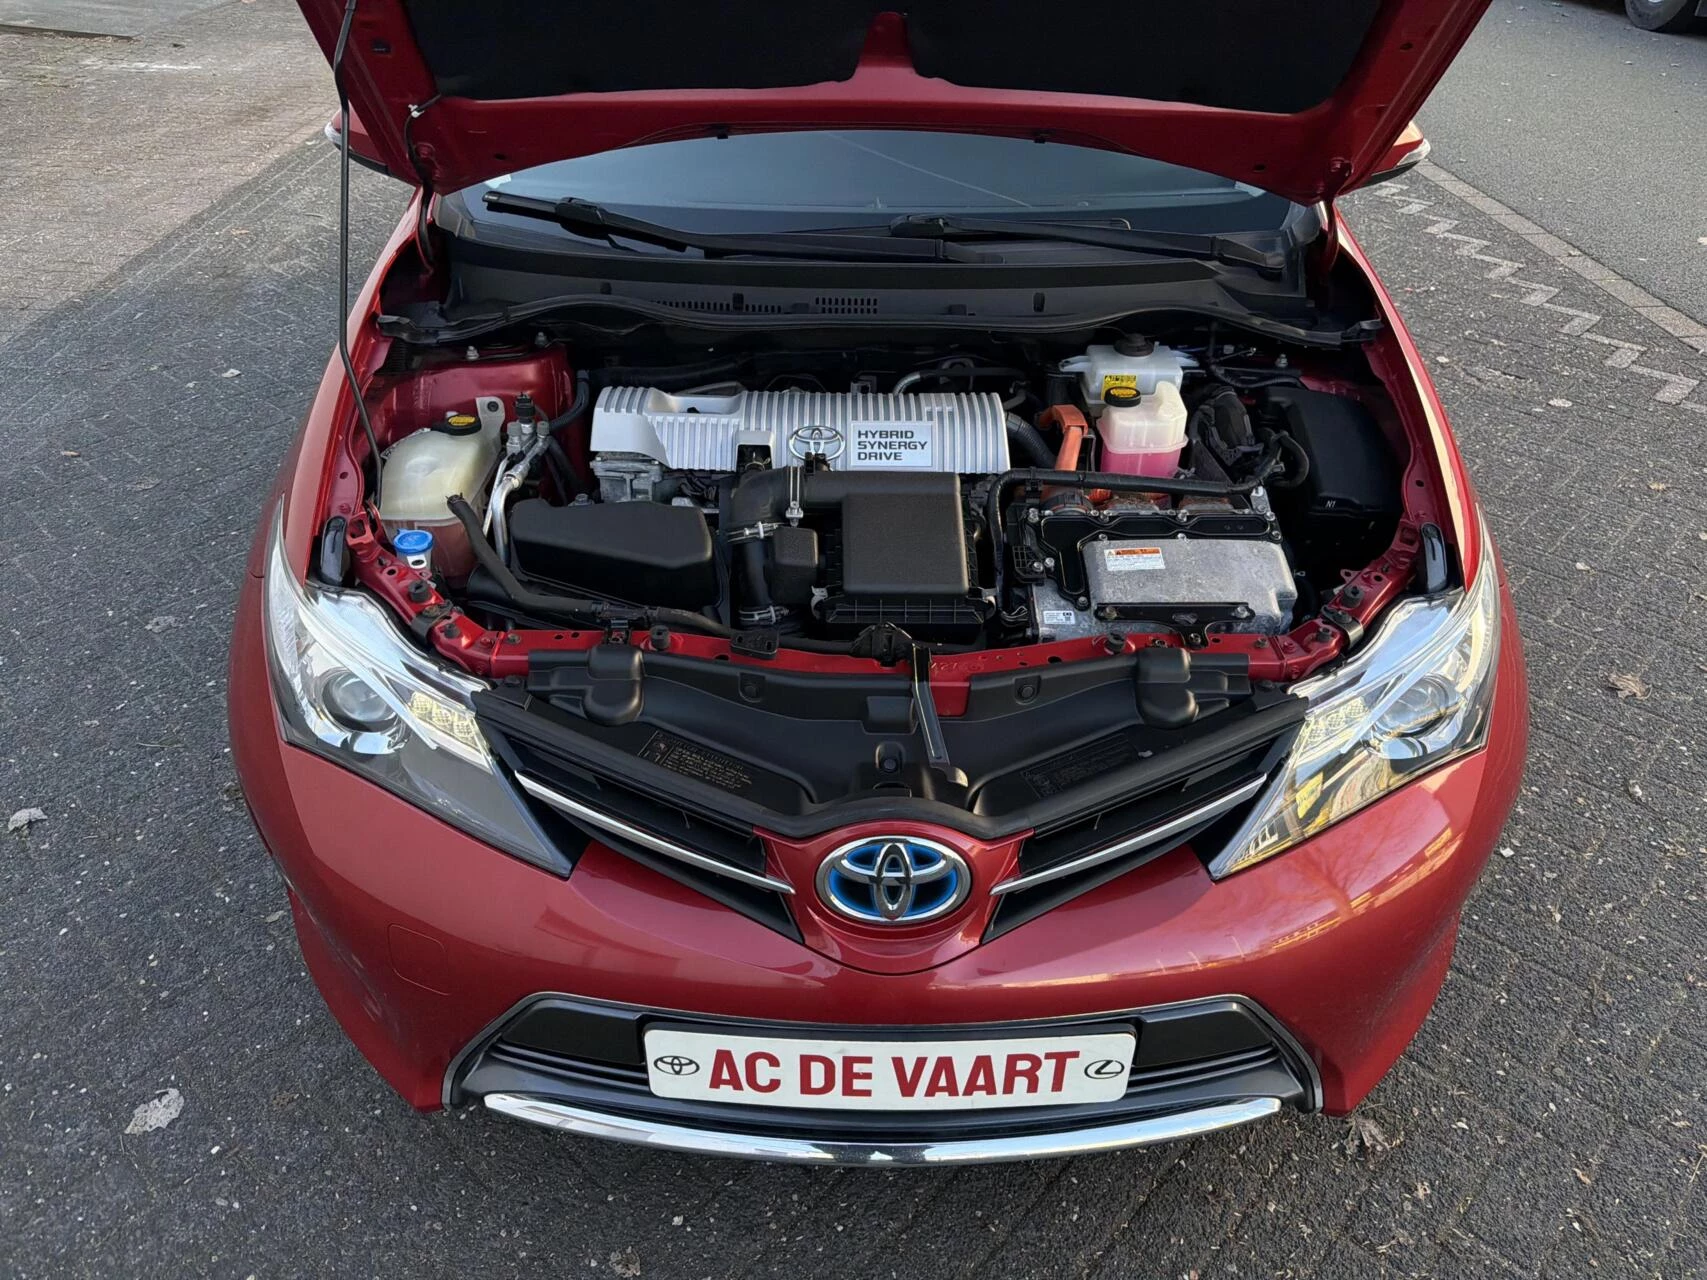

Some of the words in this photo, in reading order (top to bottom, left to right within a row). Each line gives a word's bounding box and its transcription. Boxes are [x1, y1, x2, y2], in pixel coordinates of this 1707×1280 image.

[857, 430, 914, 439] HYBRID
[857, 441, 928, 450] SYNERGY
[857, 452, 903, 461] DRIVE
[708, 1049, 782, 1094] AC
[798, 1054, 873, 1097] DE
[891, 1050, 1080, 1098] VAART
